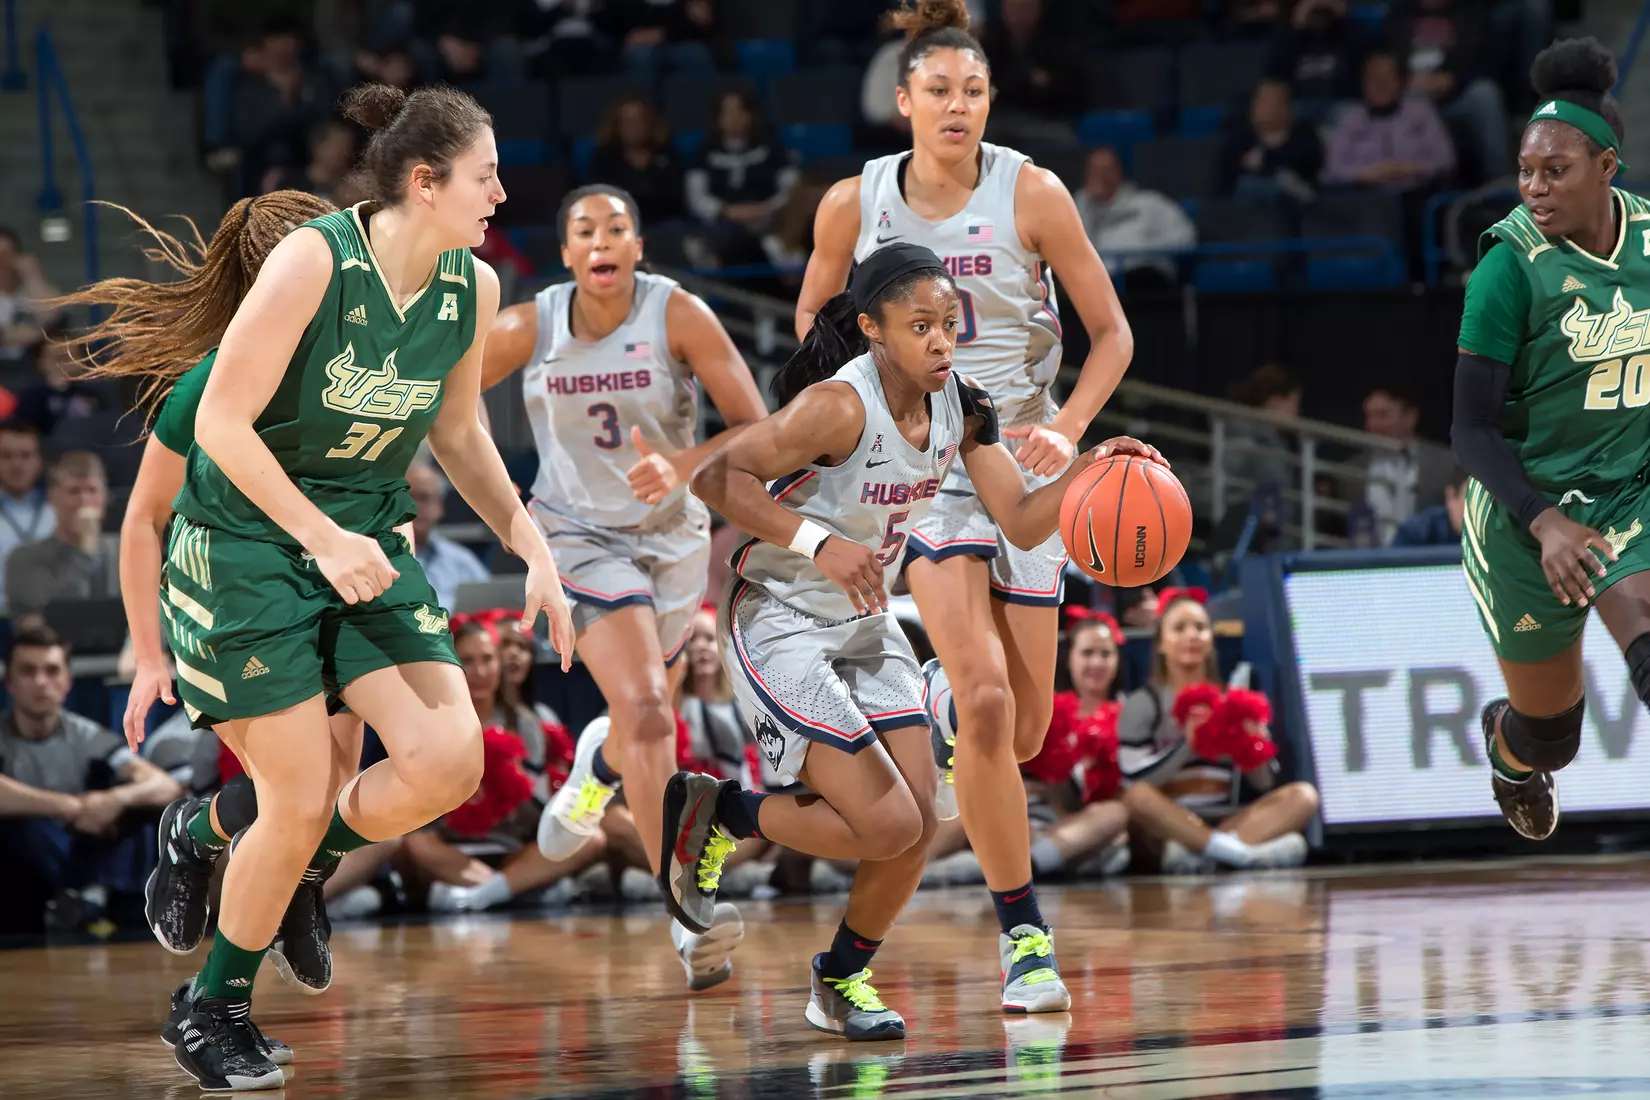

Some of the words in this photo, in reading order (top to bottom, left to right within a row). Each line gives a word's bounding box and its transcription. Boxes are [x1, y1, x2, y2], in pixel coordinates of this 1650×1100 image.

[344, 313, 369, 327] adidas
[1560, 286, 1650, 363] US
[322, 340, 441, 421] USF
[546, 369, 652, 395] HUSKIES
[1583, 353, 1650, 410] 20
[325, 421, 405, 462] 31
[587, 402, 622, 450] 3
[875, 509, 910, 567] 5
[1134, 525, 1147, 568] UCONN
[1513, 622, 1542, 632] adidas
[241, 666, 270, 680] adidas
[1310, 664, 1639, 774] TRV
